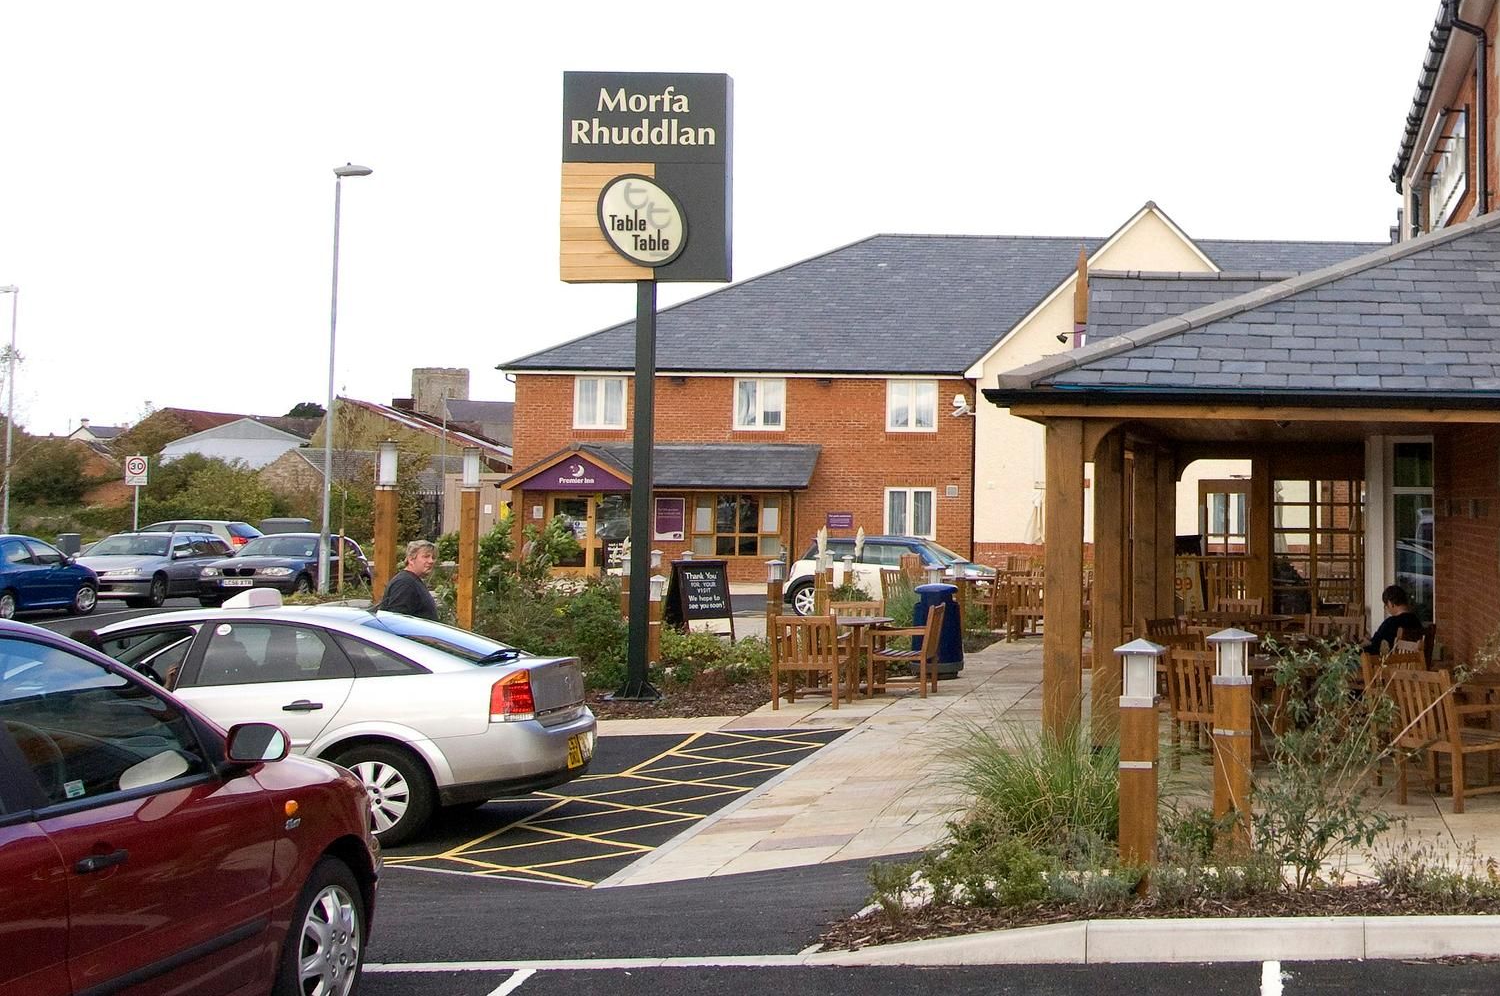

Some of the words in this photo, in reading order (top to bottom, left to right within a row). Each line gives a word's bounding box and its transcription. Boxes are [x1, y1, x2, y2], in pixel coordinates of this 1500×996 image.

[597, 86, 690, 113] Morfa
[570, 117, 716, 146] Rhuddlan
[609, 209, 647, 232] Table
[631, 229, 670, 252] Table
[130, 462, 144, 471] 30
[685, 572, 705, 580] Thank
[698, 595, 713, 603] hope
